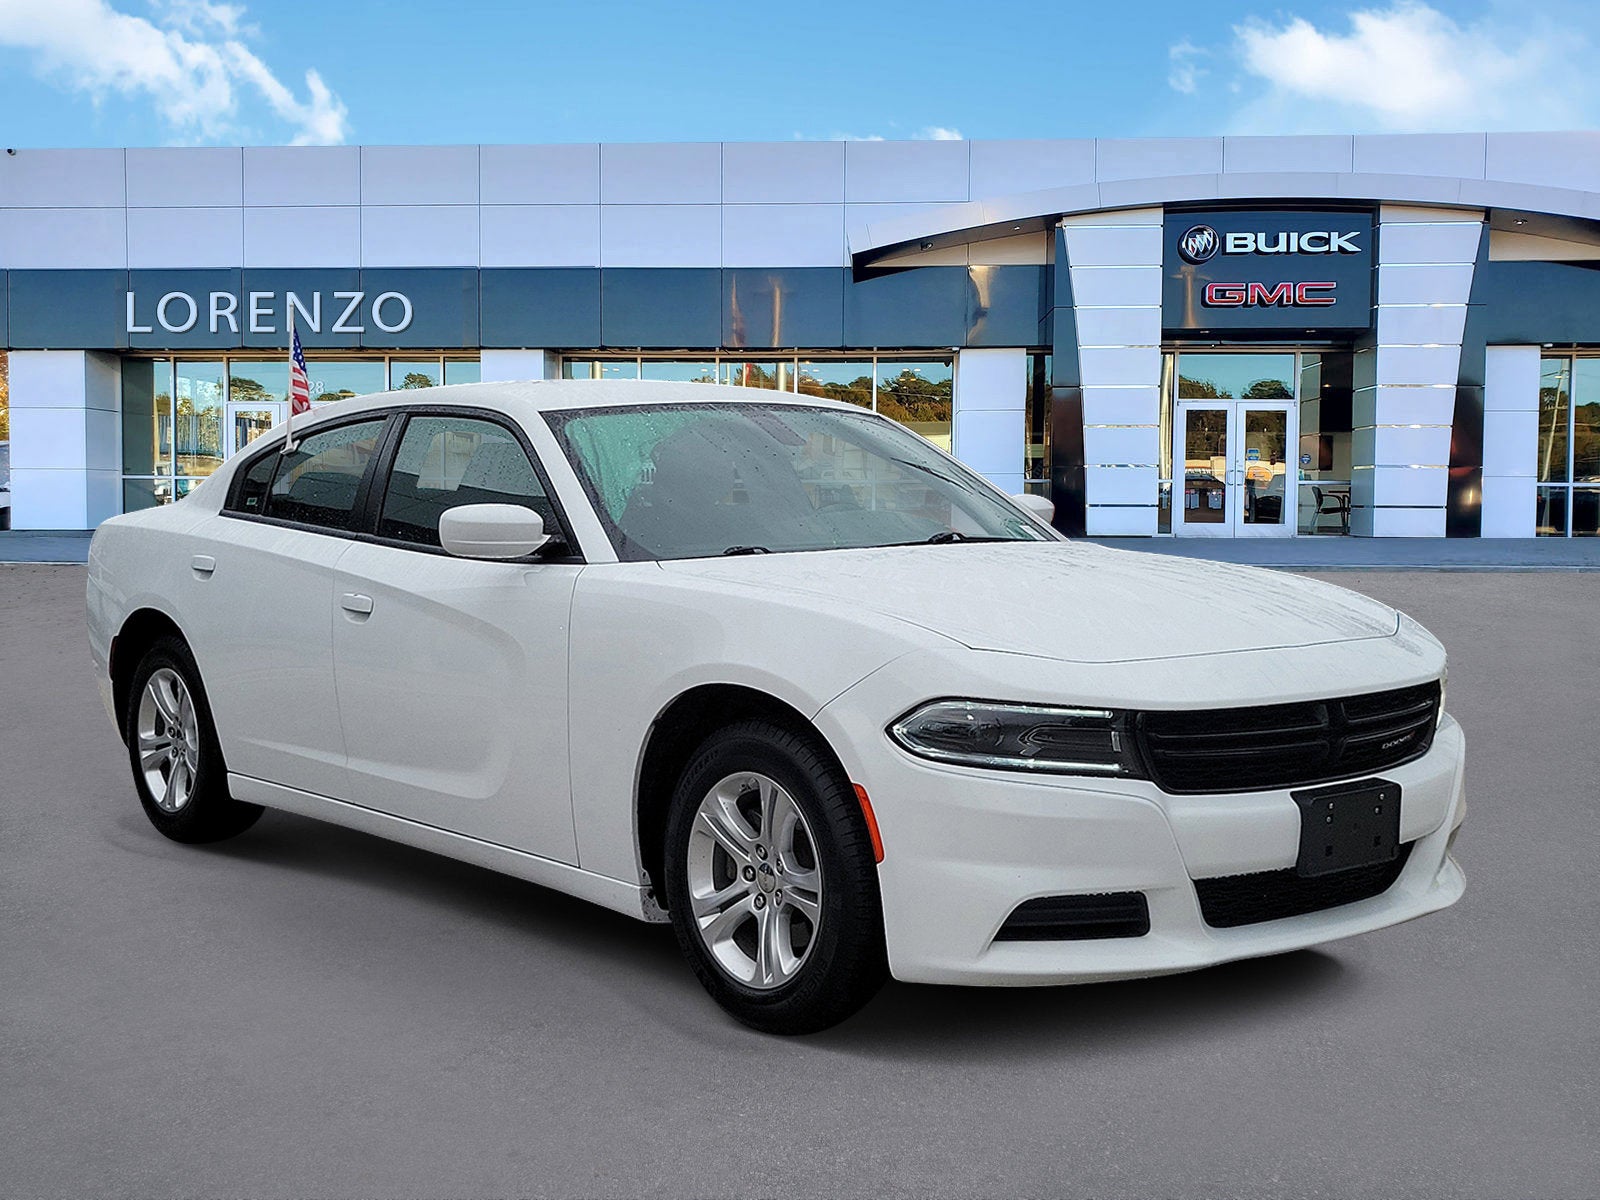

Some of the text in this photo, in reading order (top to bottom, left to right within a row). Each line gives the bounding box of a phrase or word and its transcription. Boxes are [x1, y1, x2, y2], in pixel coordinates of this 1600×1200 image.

[1225, 231, 1362, 253] BUICK
[1206, 281, 1337, 305] GMC
[126, 291, 413, 333] LORENZO
